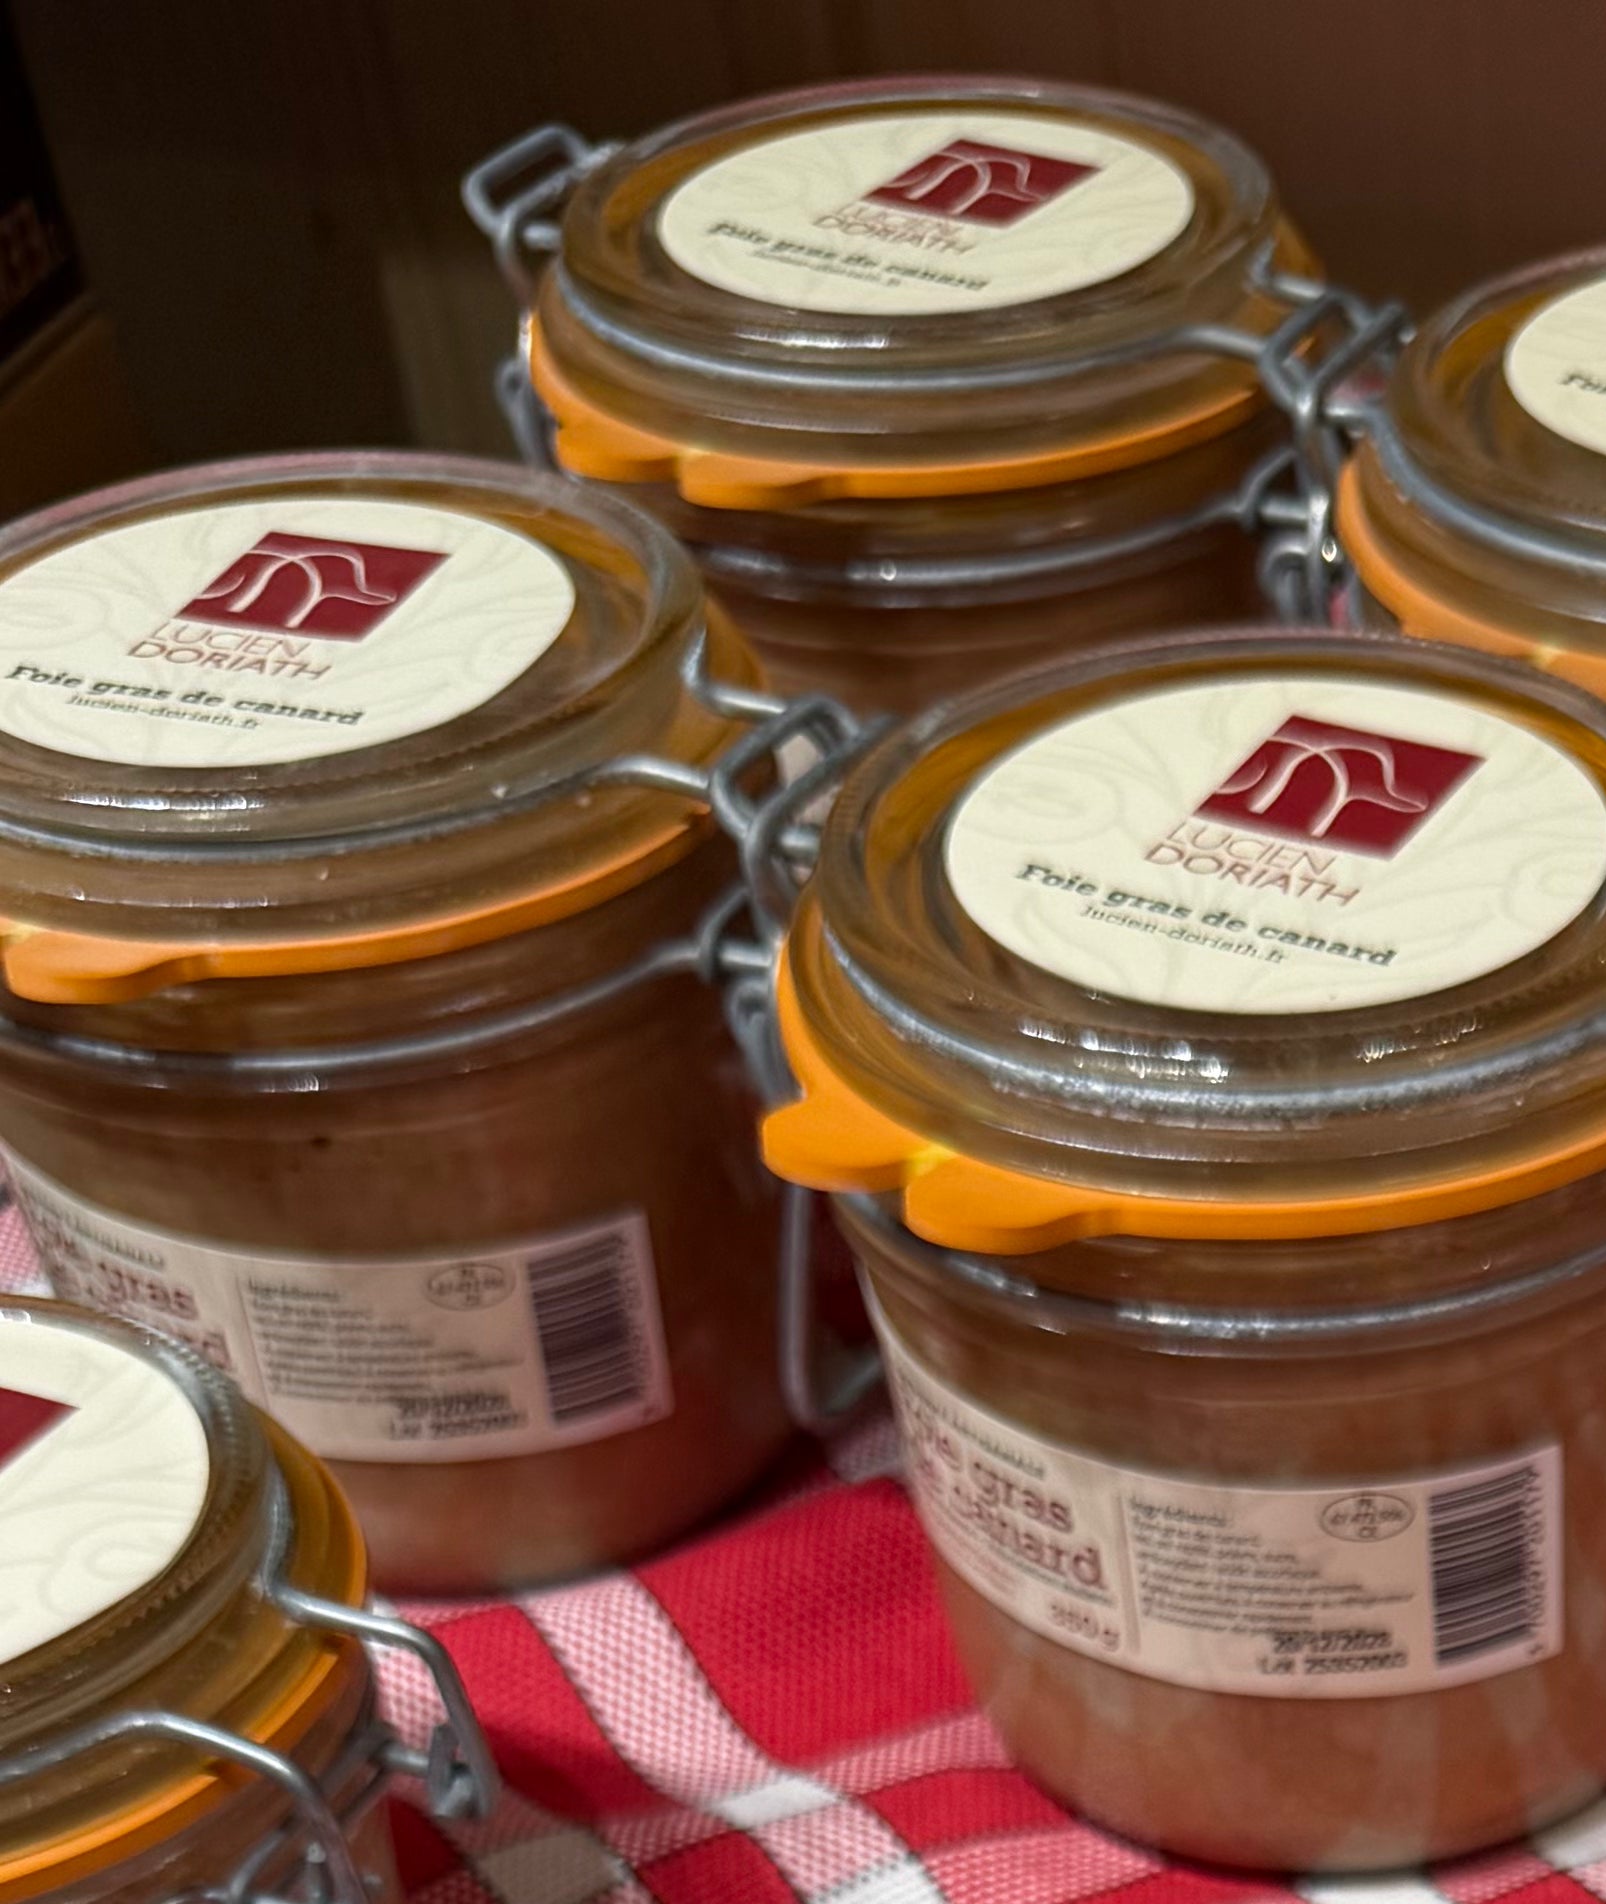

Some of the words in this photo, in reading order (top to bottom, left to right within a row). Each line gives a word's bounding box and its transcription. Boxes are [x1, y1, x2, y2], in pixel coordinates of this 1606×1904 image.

[127, 640, 331, 680] DORIATH
[150, 622, 310, 658] LUCIEN
[4, 665, 82, 688] Foie
[89, 681, 171, 702] gras
[180, 690, 223, 708] de
[234, 697, 364, 727] canard
[1144, 841, 1360, 907] DORIATH
[1167, 821, 1336, 875] LUCIEN
[1015, 863, 1097, 897] Foie
[1102, 887, 1192, 920] gras
[1202, 909, 1248, 934] de
[1258, 923, 1397, 968] canard
[1080, 905, 1287, 965] lucien-doriath.fr
